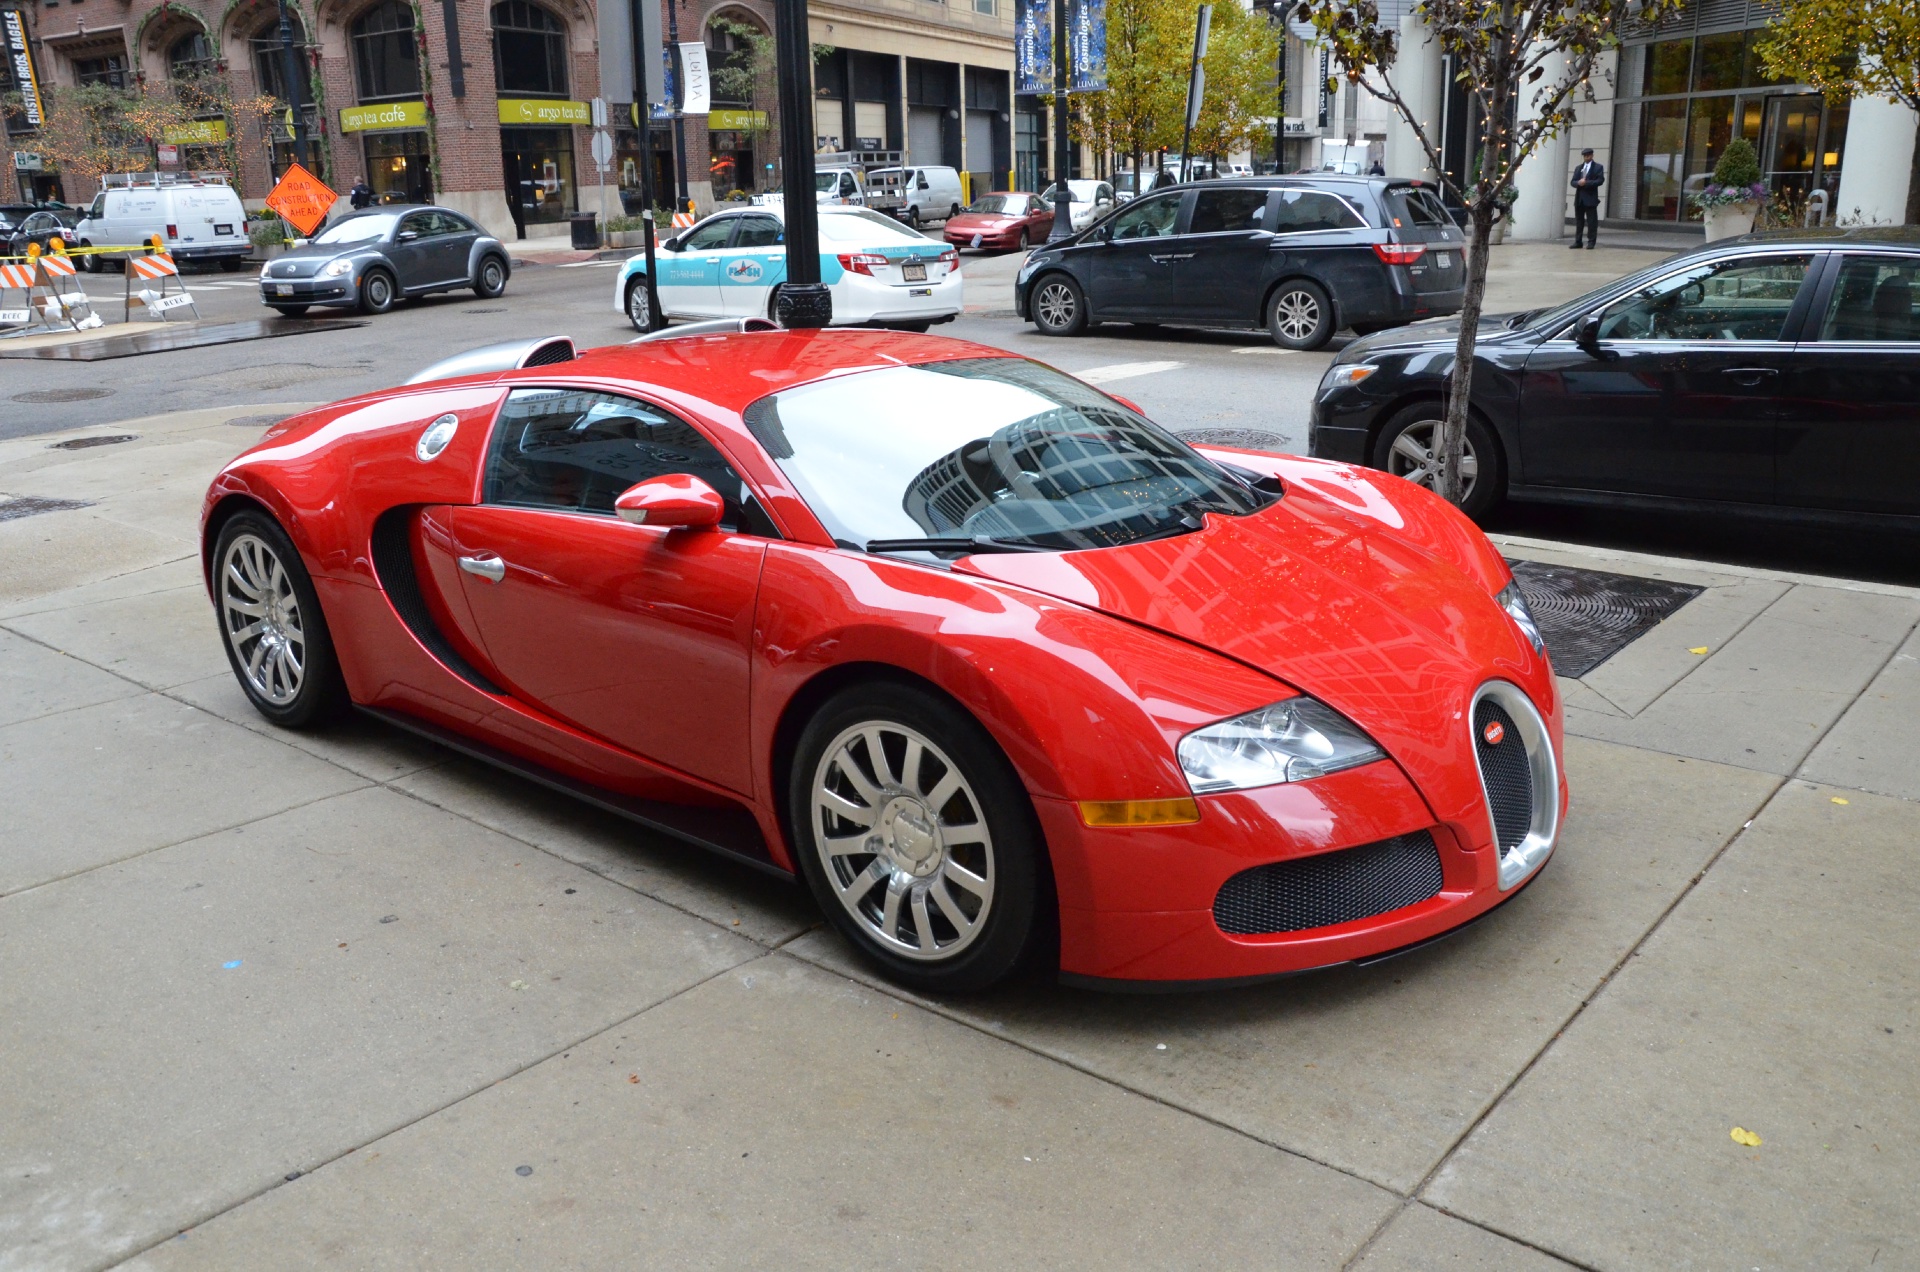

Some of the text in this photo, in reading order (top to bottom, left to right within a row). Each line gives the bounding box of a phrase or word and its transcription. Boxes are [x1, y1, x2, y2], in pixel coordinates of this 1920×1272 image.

[1024, 8, 1036, 75] Cosmologies
[1078, 4, 1090, 72] Cosmologies
[4, 11, 40, 124] EINSTEIN BROS. BAGELS
[688, 51, 703, 101] LUMA
[1022, 83, 1044, 91] LUMA
[1077, 80, 1099, 88] LUMA
[1319, 92, 1327, 114] rack
[349, 104, 406, 129] argo tea café
[538, 107, 560, 122] argo
[562, 106, 574, 119] tea
[1292, 120, 1306, 132] rack
[287, 182, 311, 191] ROAD
[270, 193, 331, 206] CONSTRUCTION
[290, 207, 318, 217] AHEAD
[728, 261, 761, 278] FLASH
[163, 297, 184, 307] RCEC
[2, 312, 22, 320] RCEC
[1486, 726, 1503, 741] BUGATTI
